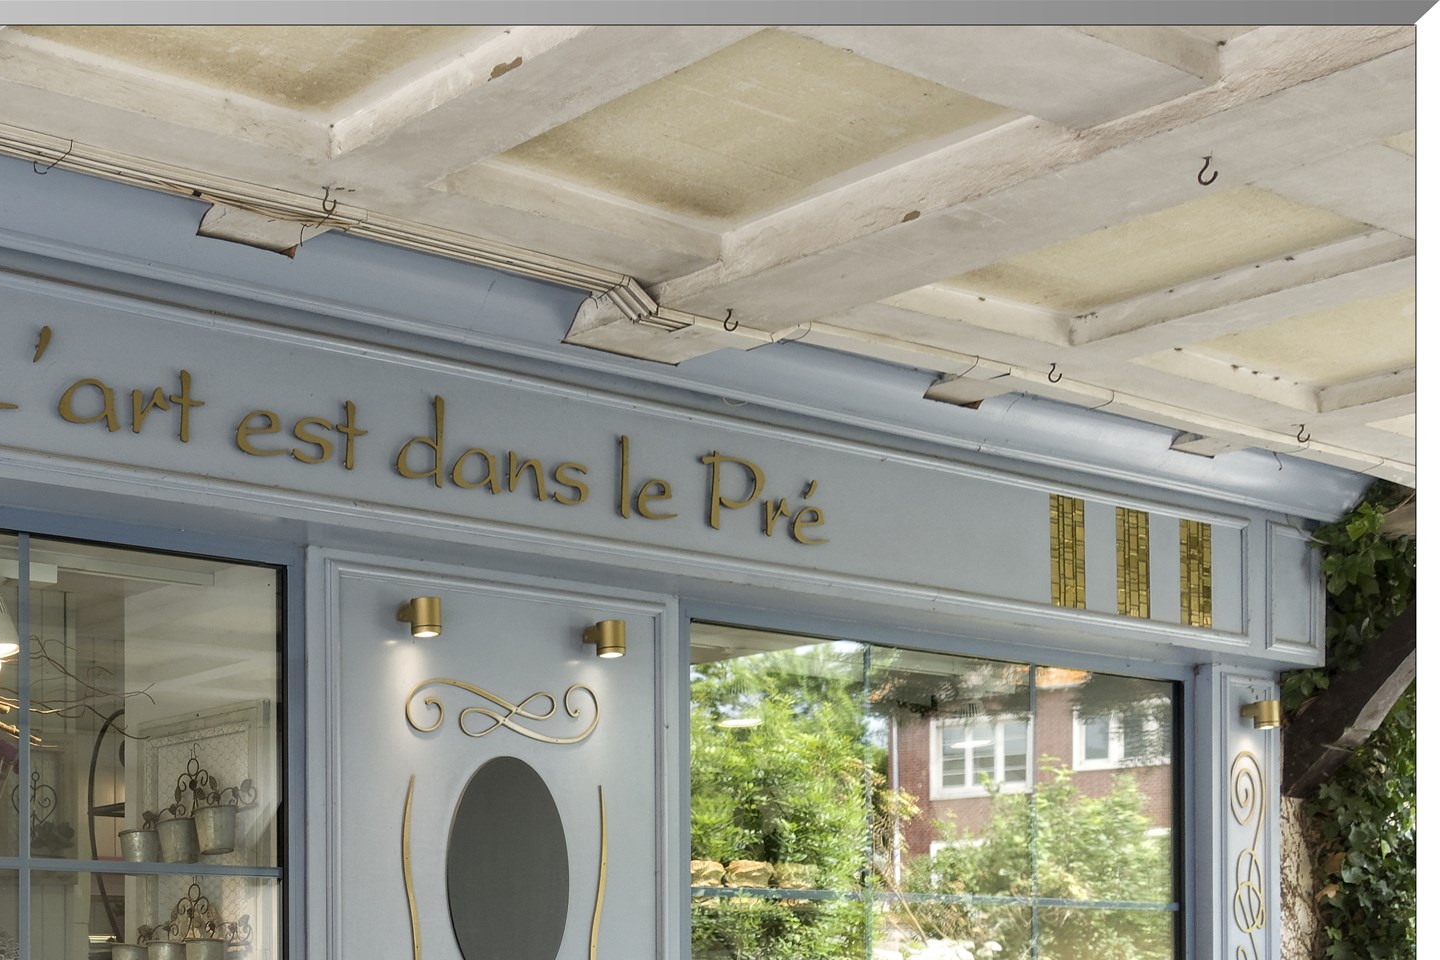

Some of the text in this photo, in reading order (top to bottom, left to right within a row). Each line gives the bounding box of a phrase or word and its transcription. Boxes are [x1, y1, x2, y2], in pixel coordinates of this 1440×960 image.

[235, 400, 369, 470] est
[395, 395, 590, 506] dans
[620, 434, 678, 520] le
[699, 451, 830, 545] Pré
